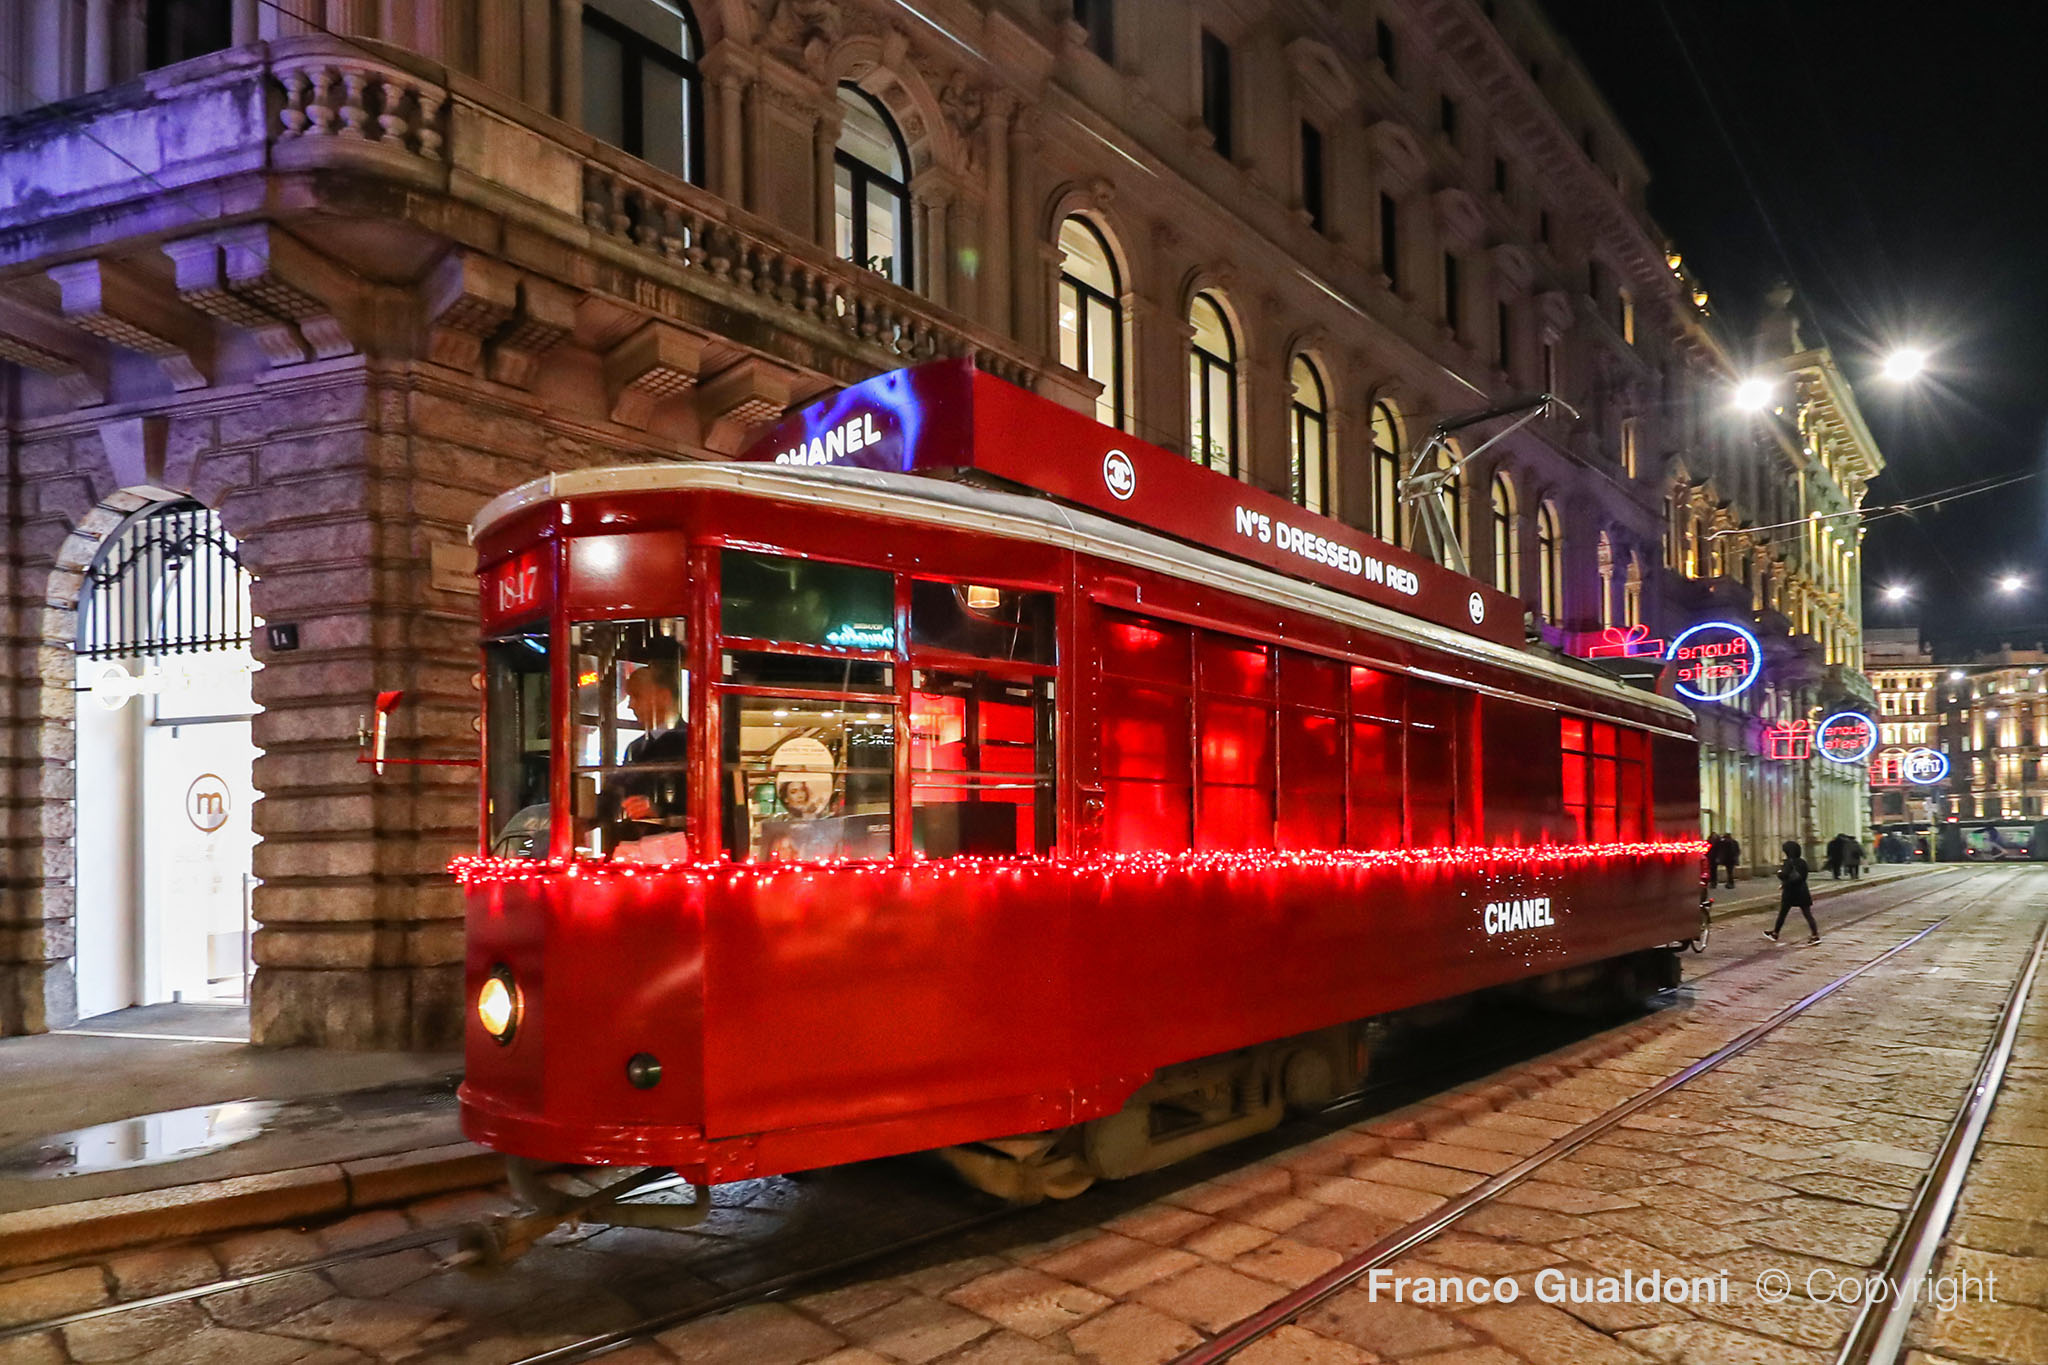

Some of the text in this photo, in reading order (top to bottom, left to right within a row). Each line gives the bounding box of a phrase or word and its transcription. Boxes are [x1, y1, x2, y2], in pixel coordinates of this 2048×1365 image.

[1276, 521, 1362, 576] DRESSED
[1365, 556, 1383, 584] IN
[1386, 564, 1418, 596] RED
[499, 565, 538, 612] 1847
[196, 792, 223, 815] m
[1484, 897, 1555, 935] CHANEL
